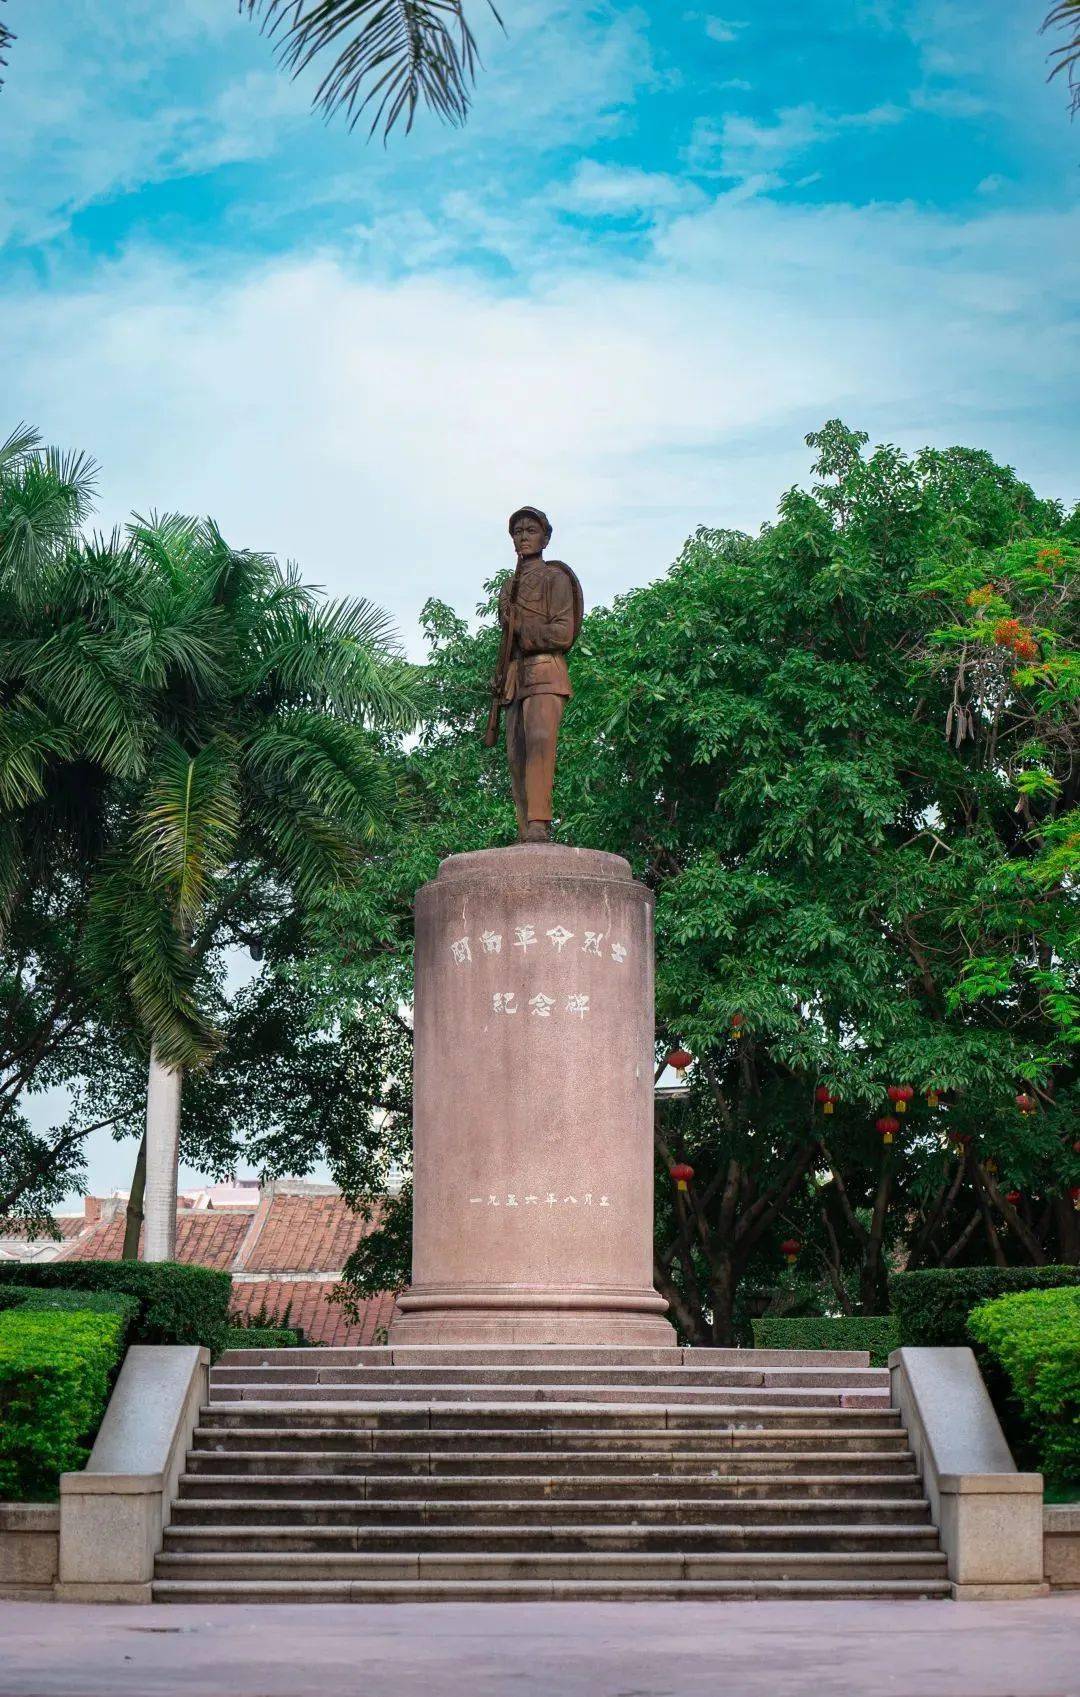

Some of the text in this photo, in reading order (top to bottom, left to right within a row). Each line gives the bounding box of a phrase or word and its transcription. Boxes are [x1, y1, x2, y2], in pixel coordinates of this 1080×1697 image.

[469, 1193, 611, 1208] 一九五六年八月立
